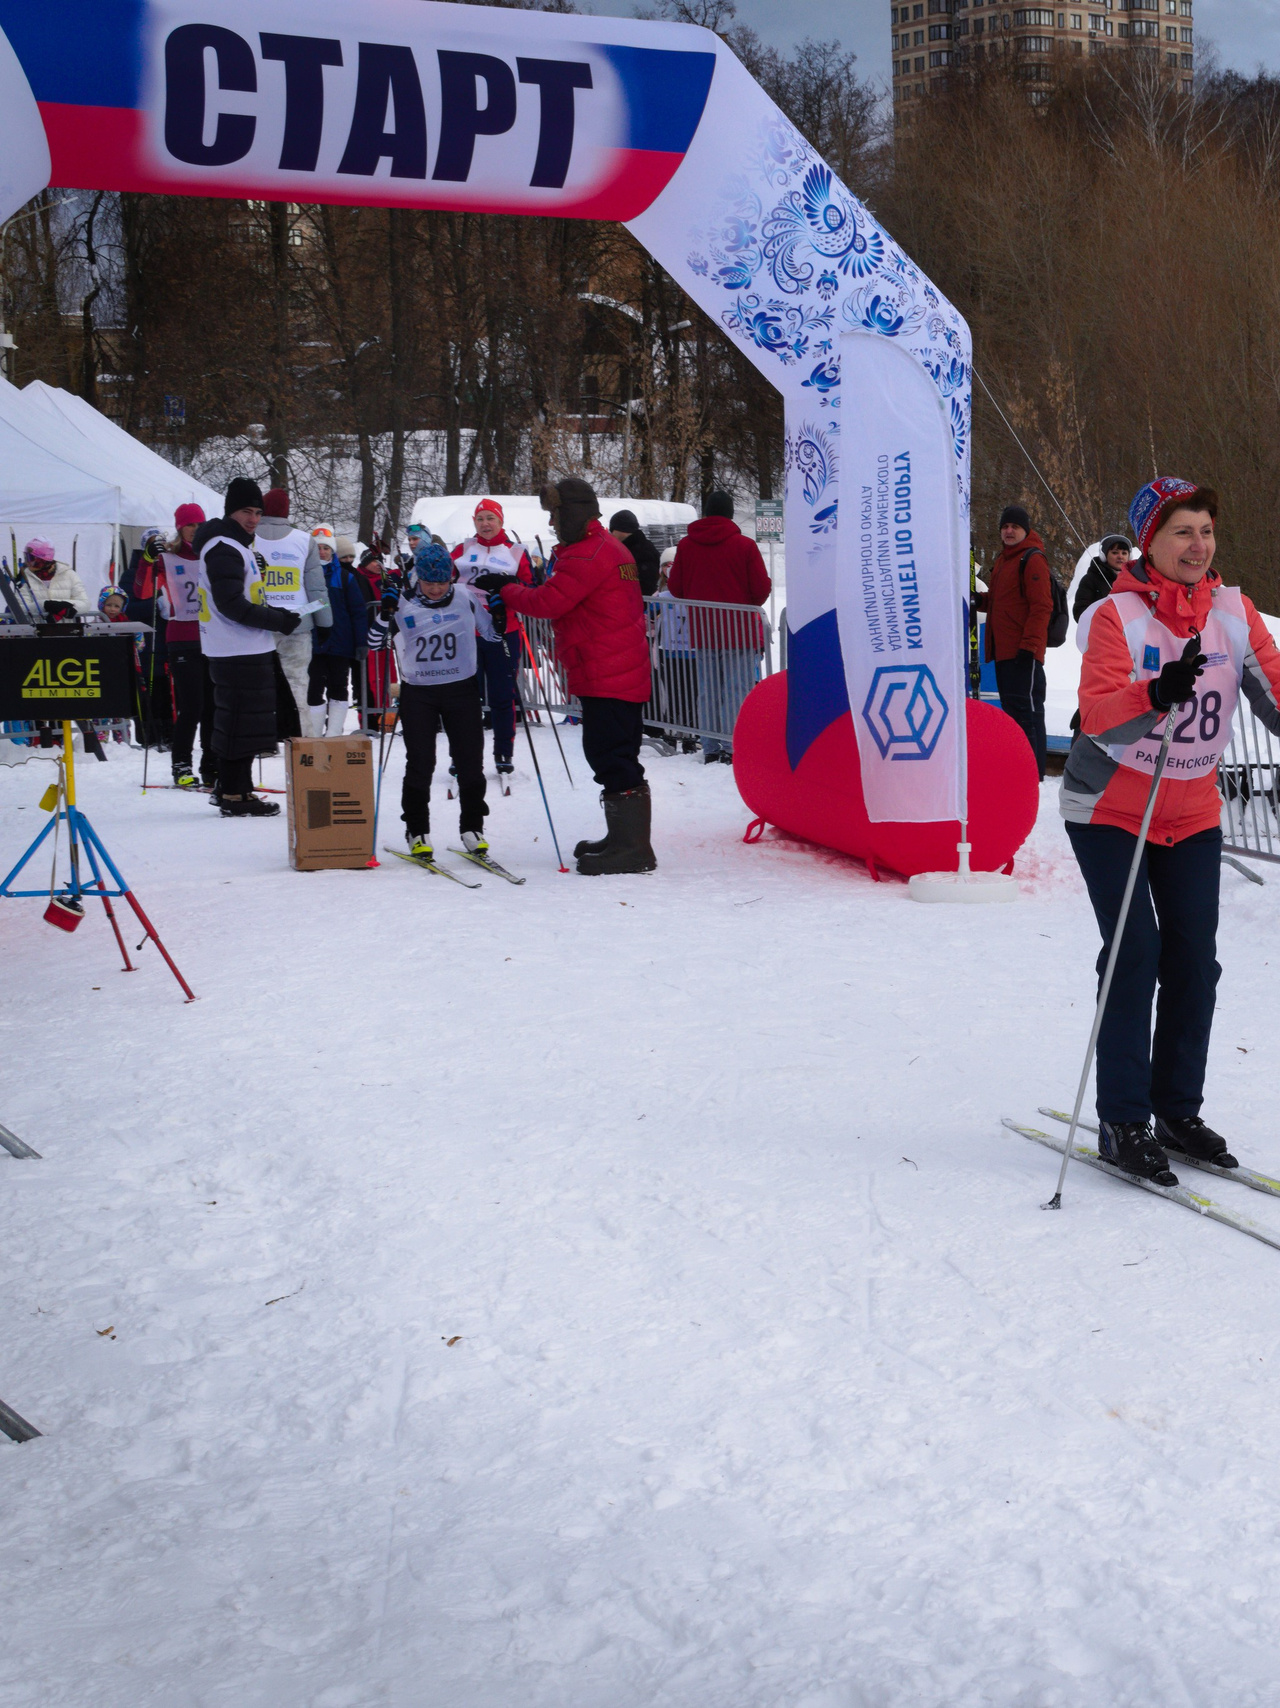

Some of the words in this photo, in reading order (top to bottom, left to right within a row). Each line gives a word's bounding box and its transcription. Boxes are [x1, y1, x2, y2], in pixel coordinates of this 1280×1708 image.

[163, 22, 594, 189] СТАРТ
[415, 632, 457, 663] 229
[22, 657, 101, 687] ALGE
[415, 667, 460, 678] РАМЕНСКОЕ
[28, 688, 95, 697] TIMING
